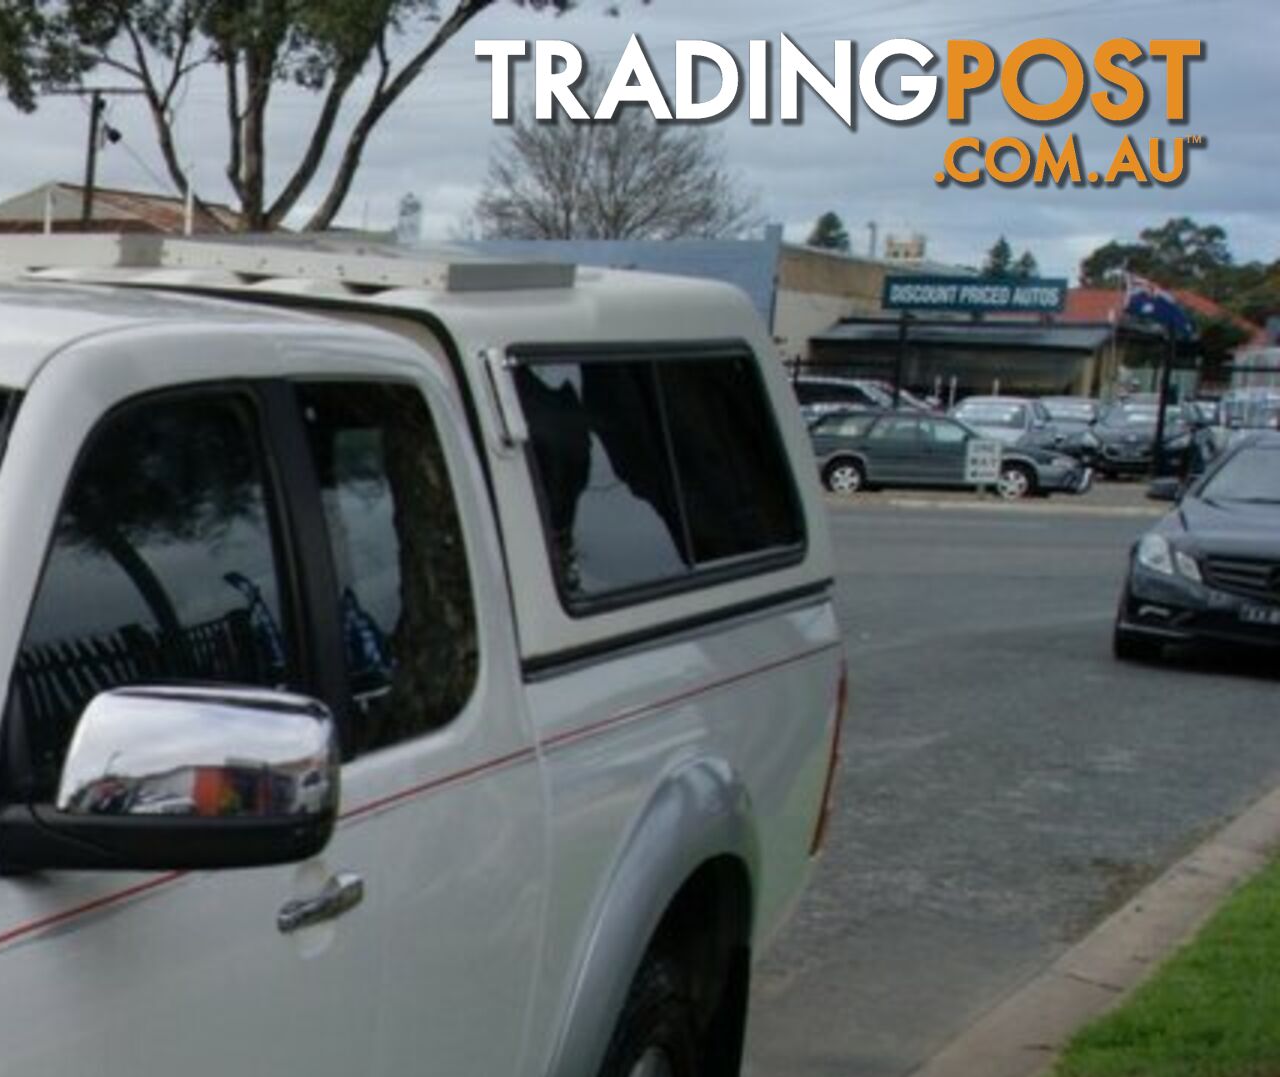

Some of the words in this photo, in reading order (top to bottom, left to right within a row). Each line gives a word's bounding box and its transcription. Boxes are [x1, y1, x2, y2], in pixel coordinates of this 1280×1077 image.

[890, 283, 957, 304] DISCOUNT
[959, 284, 1011, 305] PRICED
[1012, 285, 1060, 306] AUTOS
